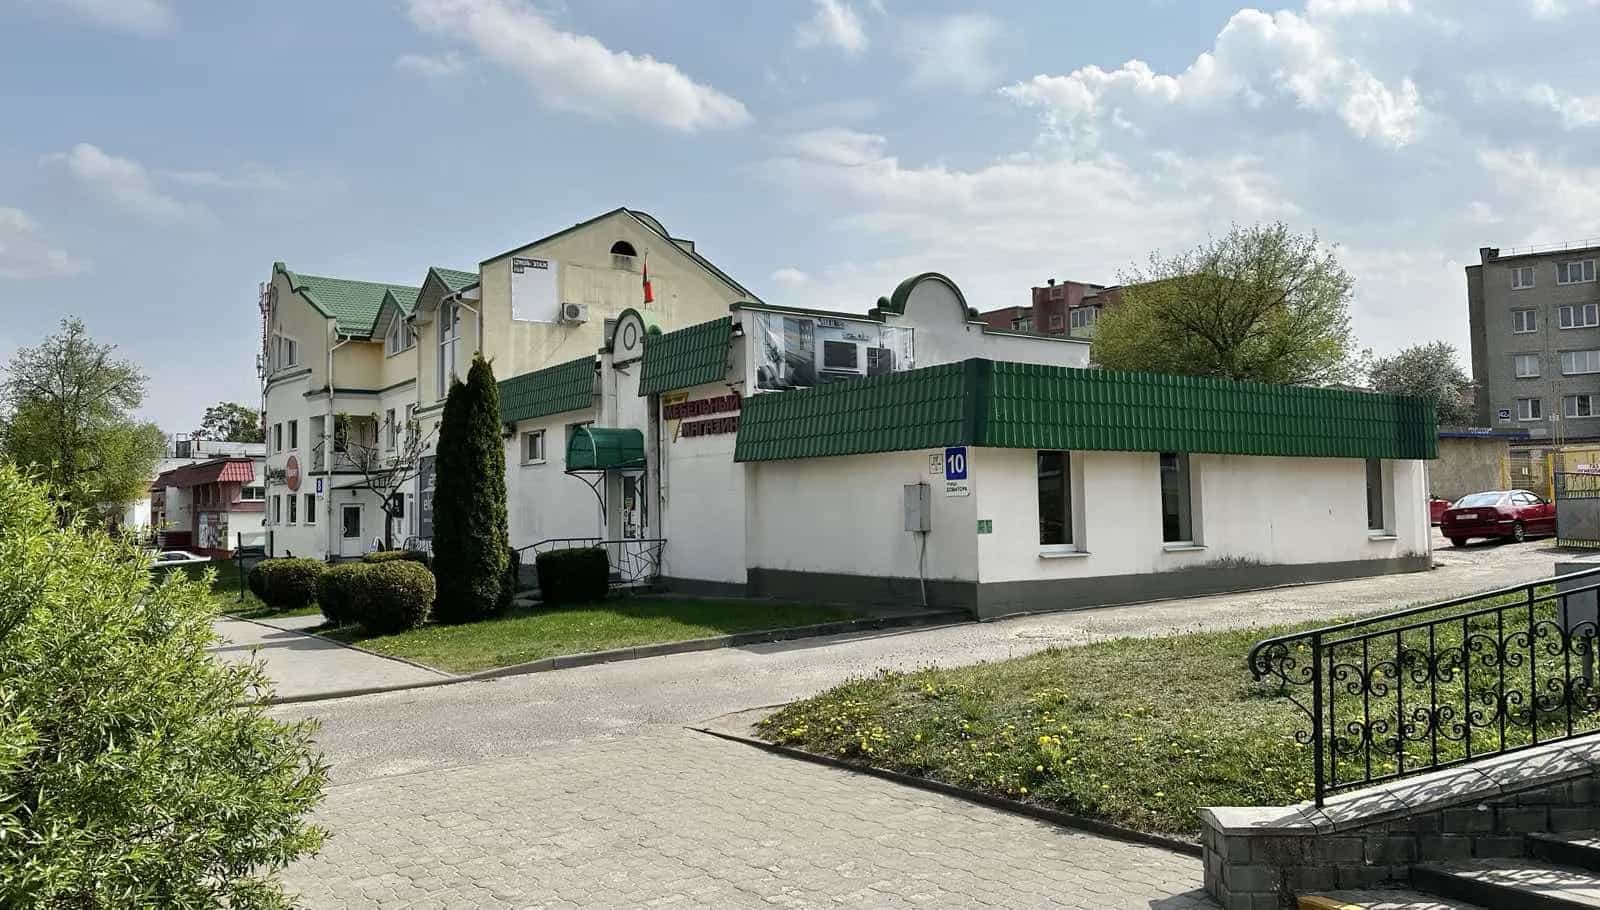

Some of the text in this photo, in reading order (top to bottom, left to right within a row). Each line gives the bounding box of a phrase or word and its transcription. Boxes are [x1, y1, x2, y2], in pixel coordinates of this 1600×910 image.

[663, 395, 738, 420] МЕБЕЛЬНЫЙ
[682, 417, 737, 437] МАГАЗИН
[947, 453, 965, 474] 10
